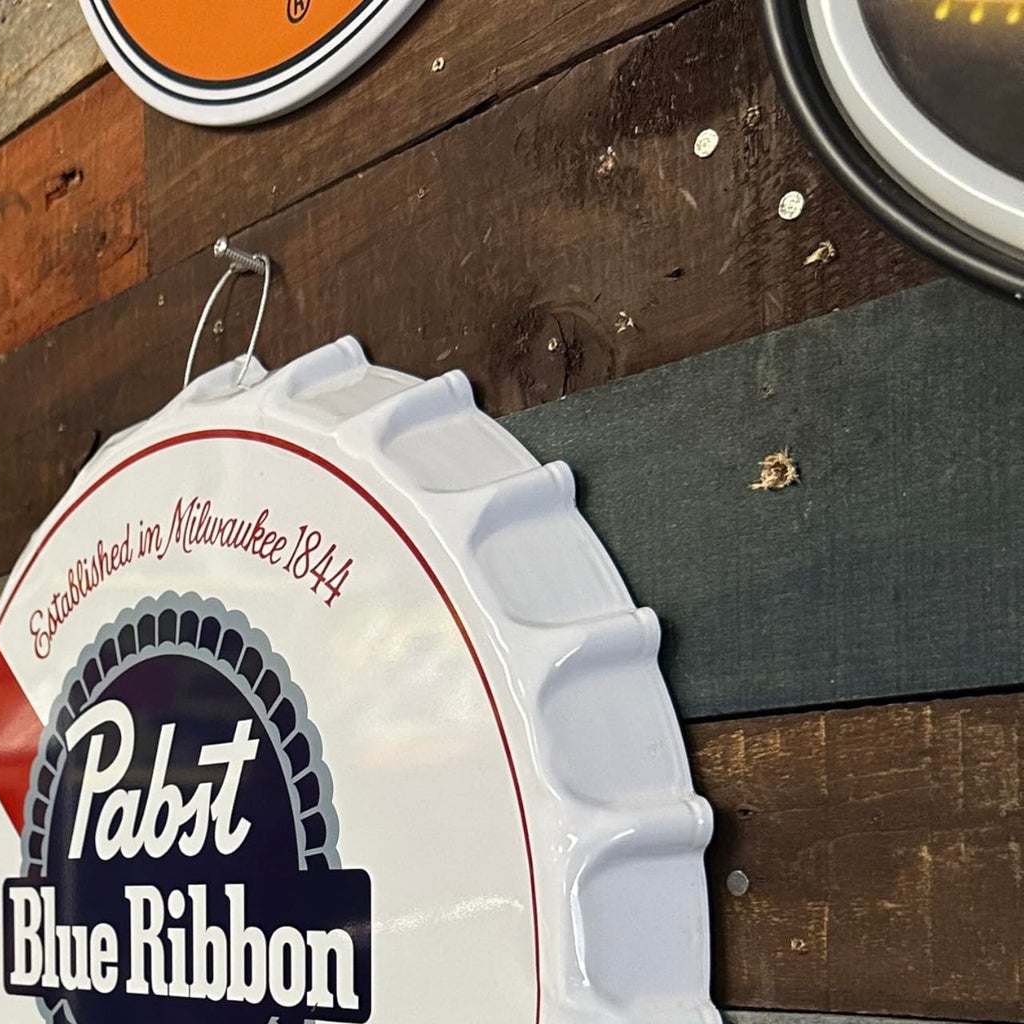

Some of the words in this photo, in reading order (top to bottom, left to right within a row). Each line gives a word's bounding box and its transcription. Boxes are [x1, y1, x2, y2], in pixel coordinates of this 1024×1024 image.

[29, 522, 134, 660] Established
[137, 519, 164, 560] in
[157, 495, 288, 566] Milwaukee
[282, 524, 354, 608] 1844
[64, 699, 261, 861] Pabst
[9, 885, 119, 994] Blue
[124, 882, 360, 1011] Ribbon
